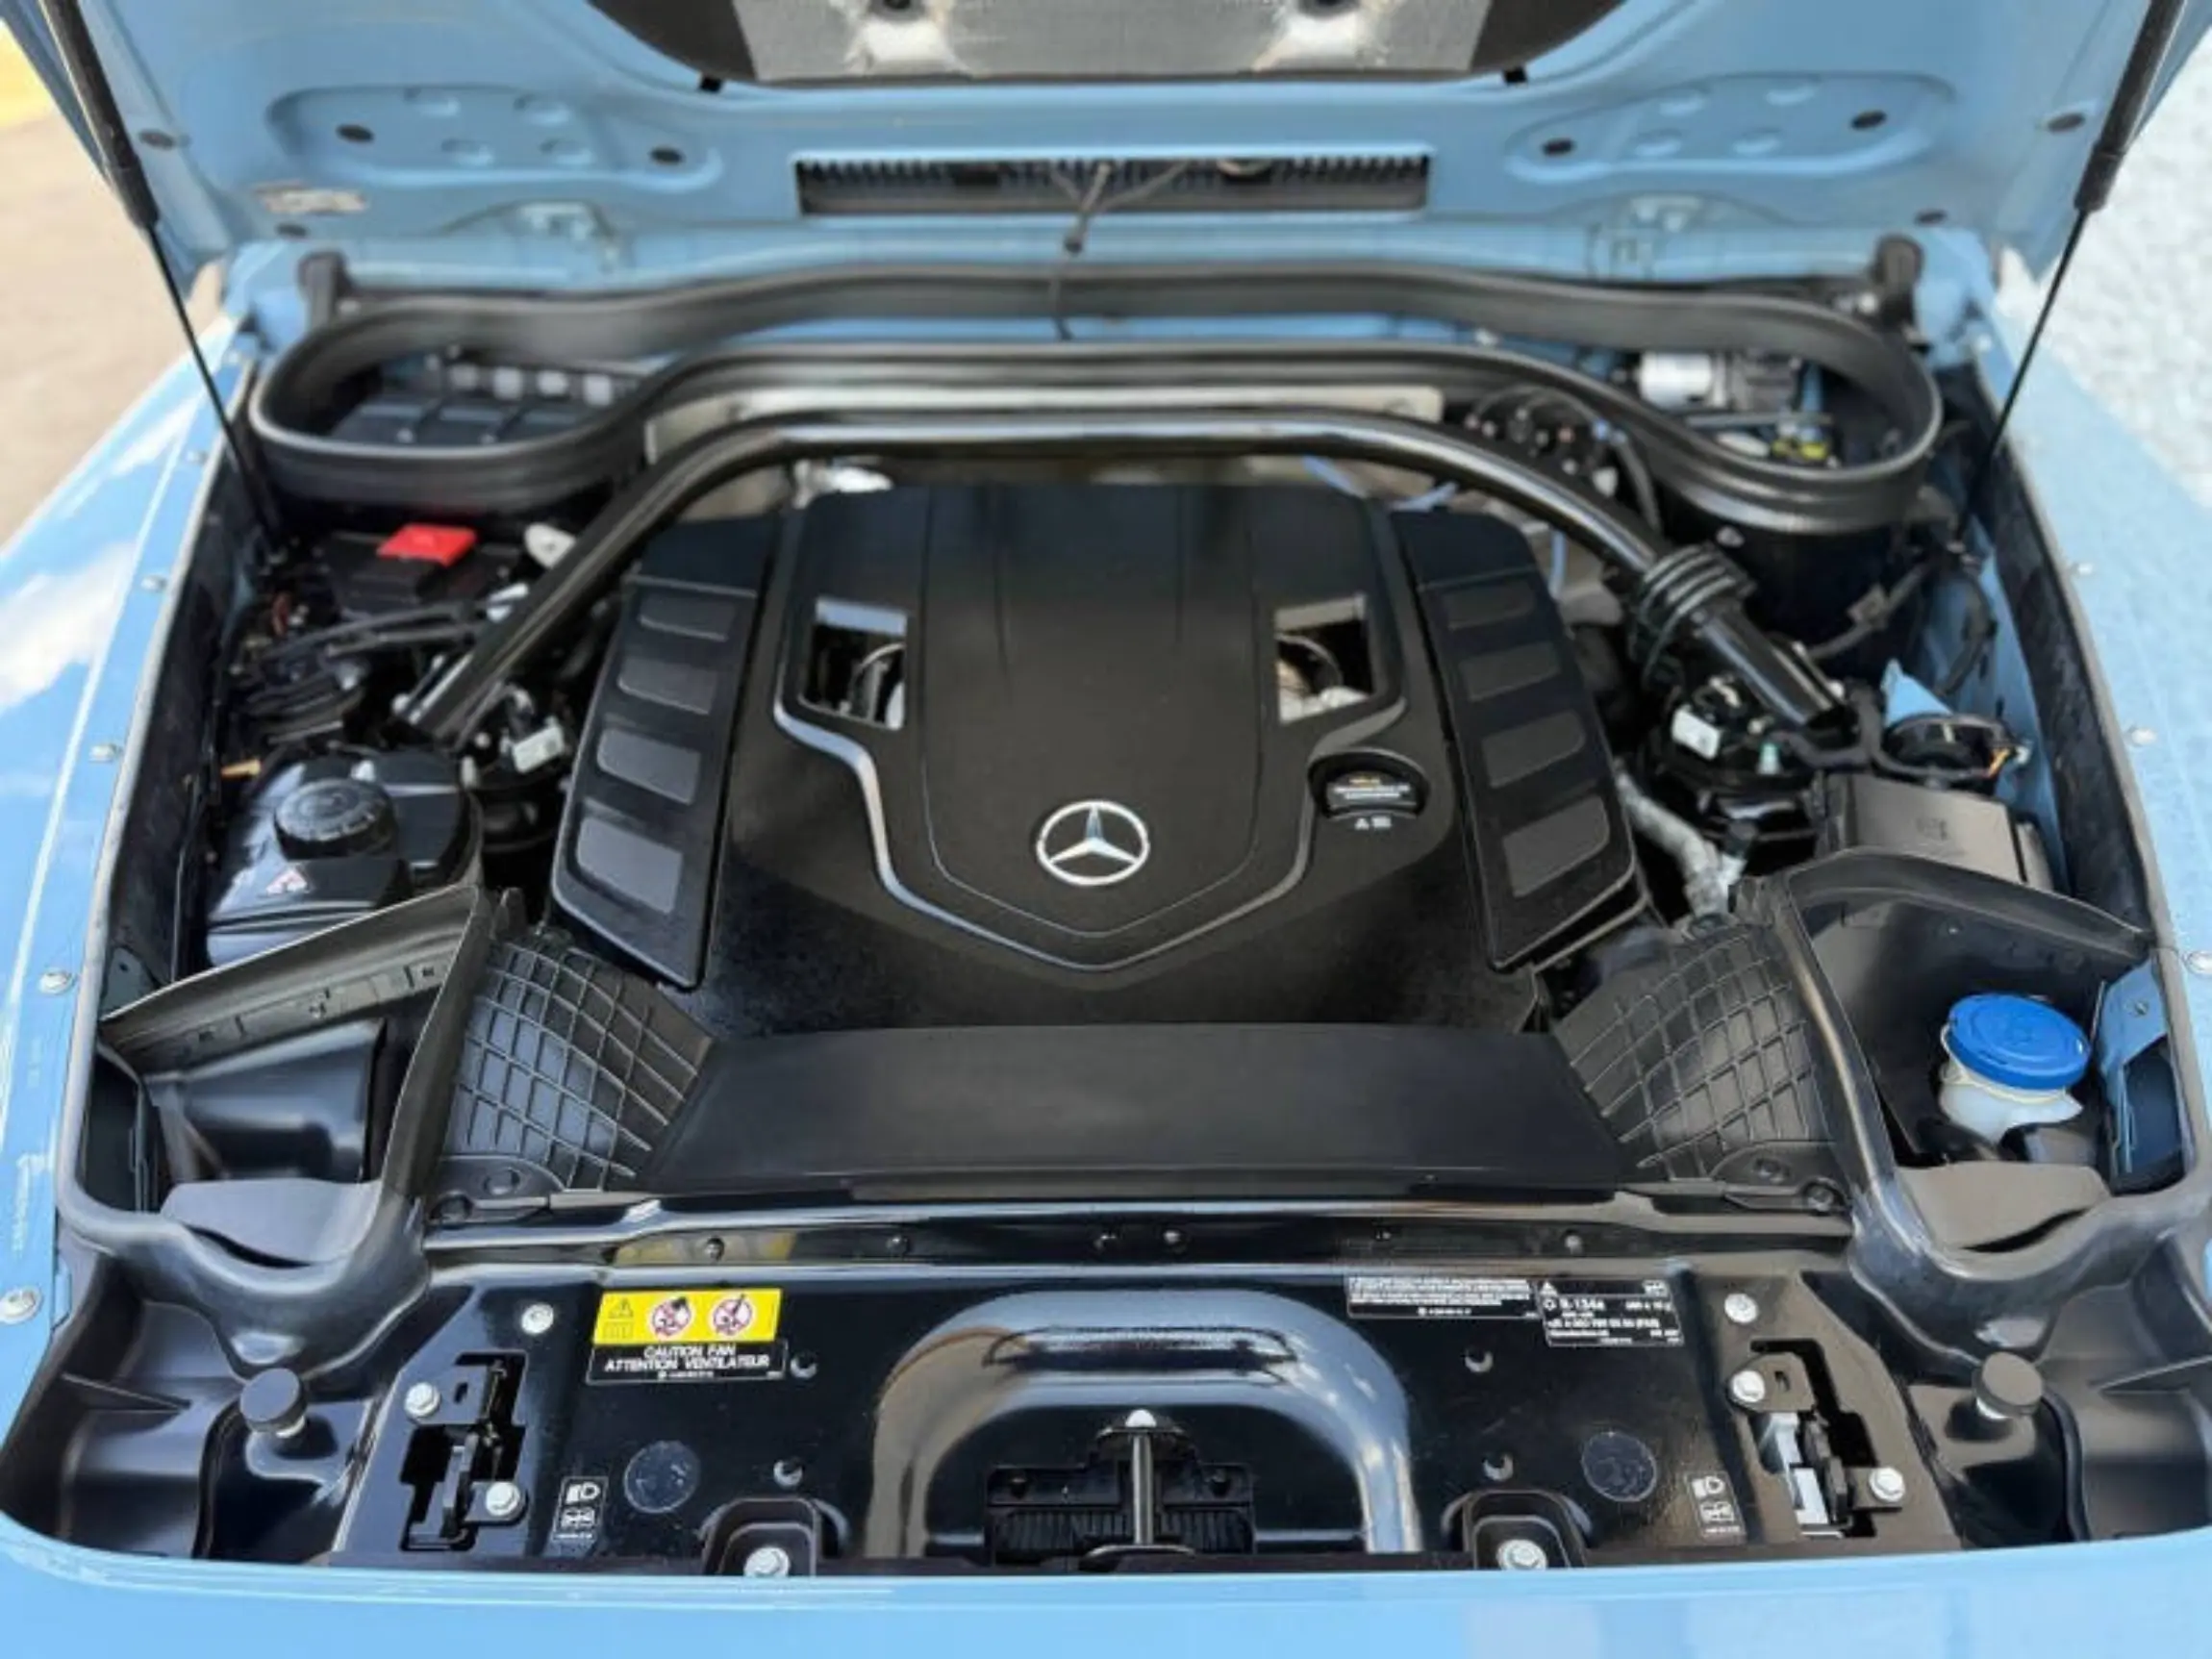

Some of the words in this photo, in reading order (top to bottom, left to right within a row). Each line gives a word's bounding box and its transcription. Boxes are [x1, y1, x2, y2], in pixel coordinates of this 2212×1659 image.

[643, 1345, 703, 1359] CAUTION
[708, 1344, 737, 1357] FAN
[604, 1357, 678, 1372] ATTENTION
[685, 1354, 770, 1370] VENTILATEUR
